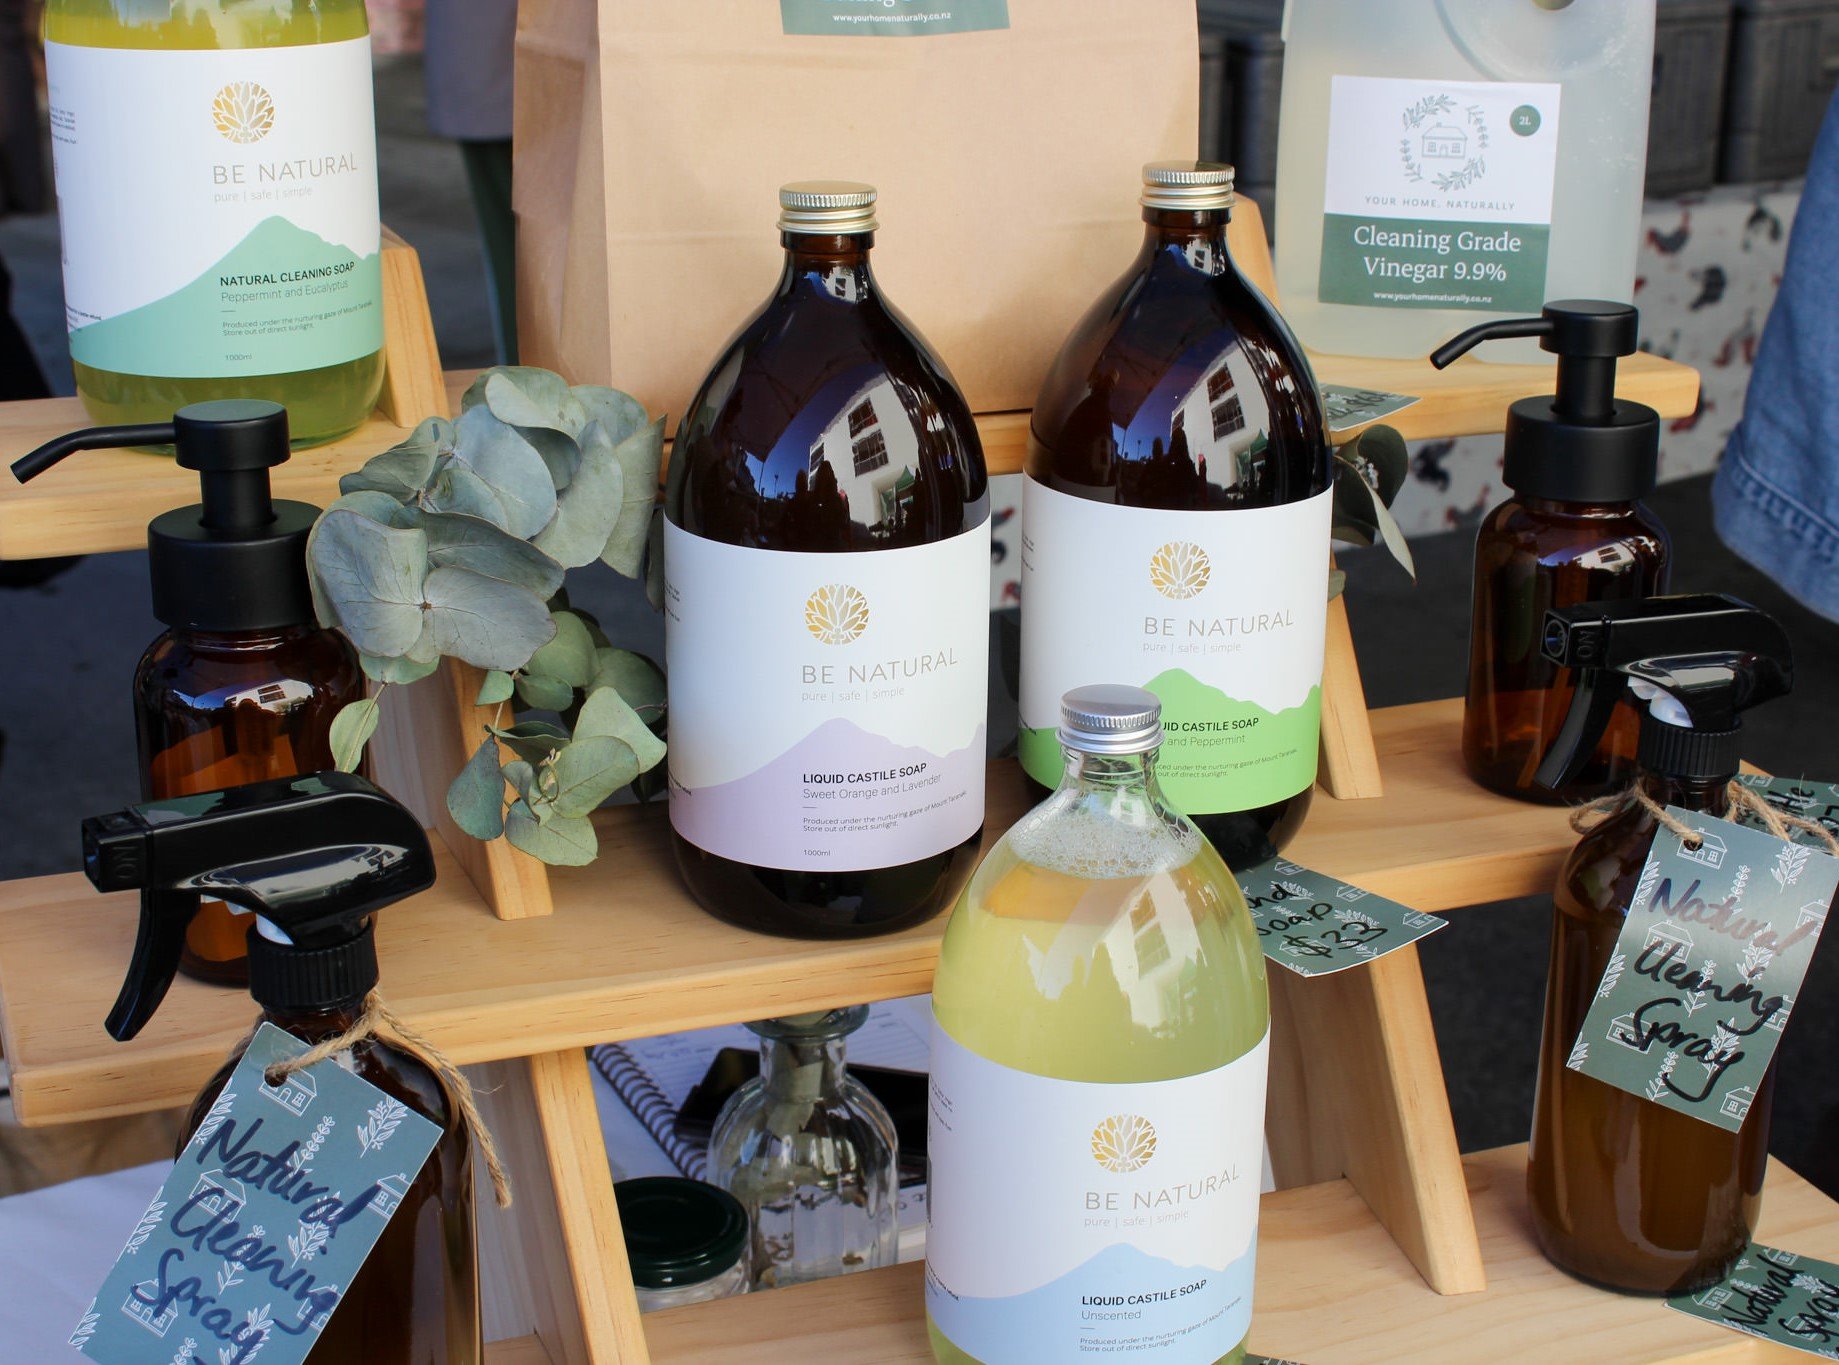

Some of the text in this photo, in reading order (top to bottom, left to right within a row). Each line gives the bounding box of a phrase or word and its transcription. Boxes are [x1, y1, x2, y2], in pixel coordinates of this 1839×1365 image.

[213, 152, 358, 185] BE NATURAL
[214, 192, 239, 203] pure
[251, 190, 272, 200] safe
[1365, 196, 1397, 206] YOUR
[1447, 200, 1515, 211] NATURALLY
[1354, 225, 1522, 255] Cleaning Grade
[220, 261, 356, 287] NATURAL CLEANING SOAP
[1363, 256, 1507, 284] Vinegar 9.9%
[221, 279, 350, 304] Peppermint and Eucalyptus
[223, 320, 258, 329] Produced
[259, 318, 281, 327] under
[282, 316, 293, 325] the
[245, 328, 257, 336] out
[1145, 609, 1294, 637] BE NATURAL
[1143, 642, 1241, 654] pure safe simple
[802, 647, 958, 684] BE NATURAL
[802, 687, 905, 703] pure safe simple
[1182, 721, 1229, 732] CASTILE
[1232, 717, 1260, 730] SOAP
[1167, 735, 1246, 749] and Peppermint
[803, 762, 927, 785] LIQUID CASTILE SOAP
[1171, 770, 1179, 778] of
[1180, 771, 1200, 779] direct
[1174, 763, 1195, 771] under
[1196, 763, 1207, 771] the
[1208, 763, 1239, 772] nurturing
[803, 773, 943, 800] Sweet Orange and Lavender
[803, 817, 839, 825] Produced
[840, 816, 862, 824] under
[863, 815, 876, 824] the
[877, 810, 908, 822] nurturing
[909, 807, 923, 818] gaze
[931, 799, 948, 810] Mount
[824, 825, 838, 833] out
[839, 824, 847, 832] of
[848, 823, 868, 832] direct
[803, 849, 831, 857] 1000ml
[1649, 878, 1817, 956] Natural
[1634, 940, 1784, 1036] Cleaning
[1620, 997, 1746, 1103] Spray
[197, 1118, 382, 1238] Natural
[1085, 1163, 1240, 1210] BE NATURAL
[1084, 1210, 1189, 1228] pure safe simple
[171, 1187, 338, 1335] Cleaning
[1082, 1279, 1207, 1306] LIQUID CASTILE SOAP
[1081, 1309, 1142, 1321] Unscented
[1118, 1337, 1140, 1345] under
[1156, 1328, 1187, 1340] nurturing
[1188, 1322, 1202, 1333] gaze
[1116, 1344, 1125, 1352] of
[1126, 1343, 1147, 1351] direct
